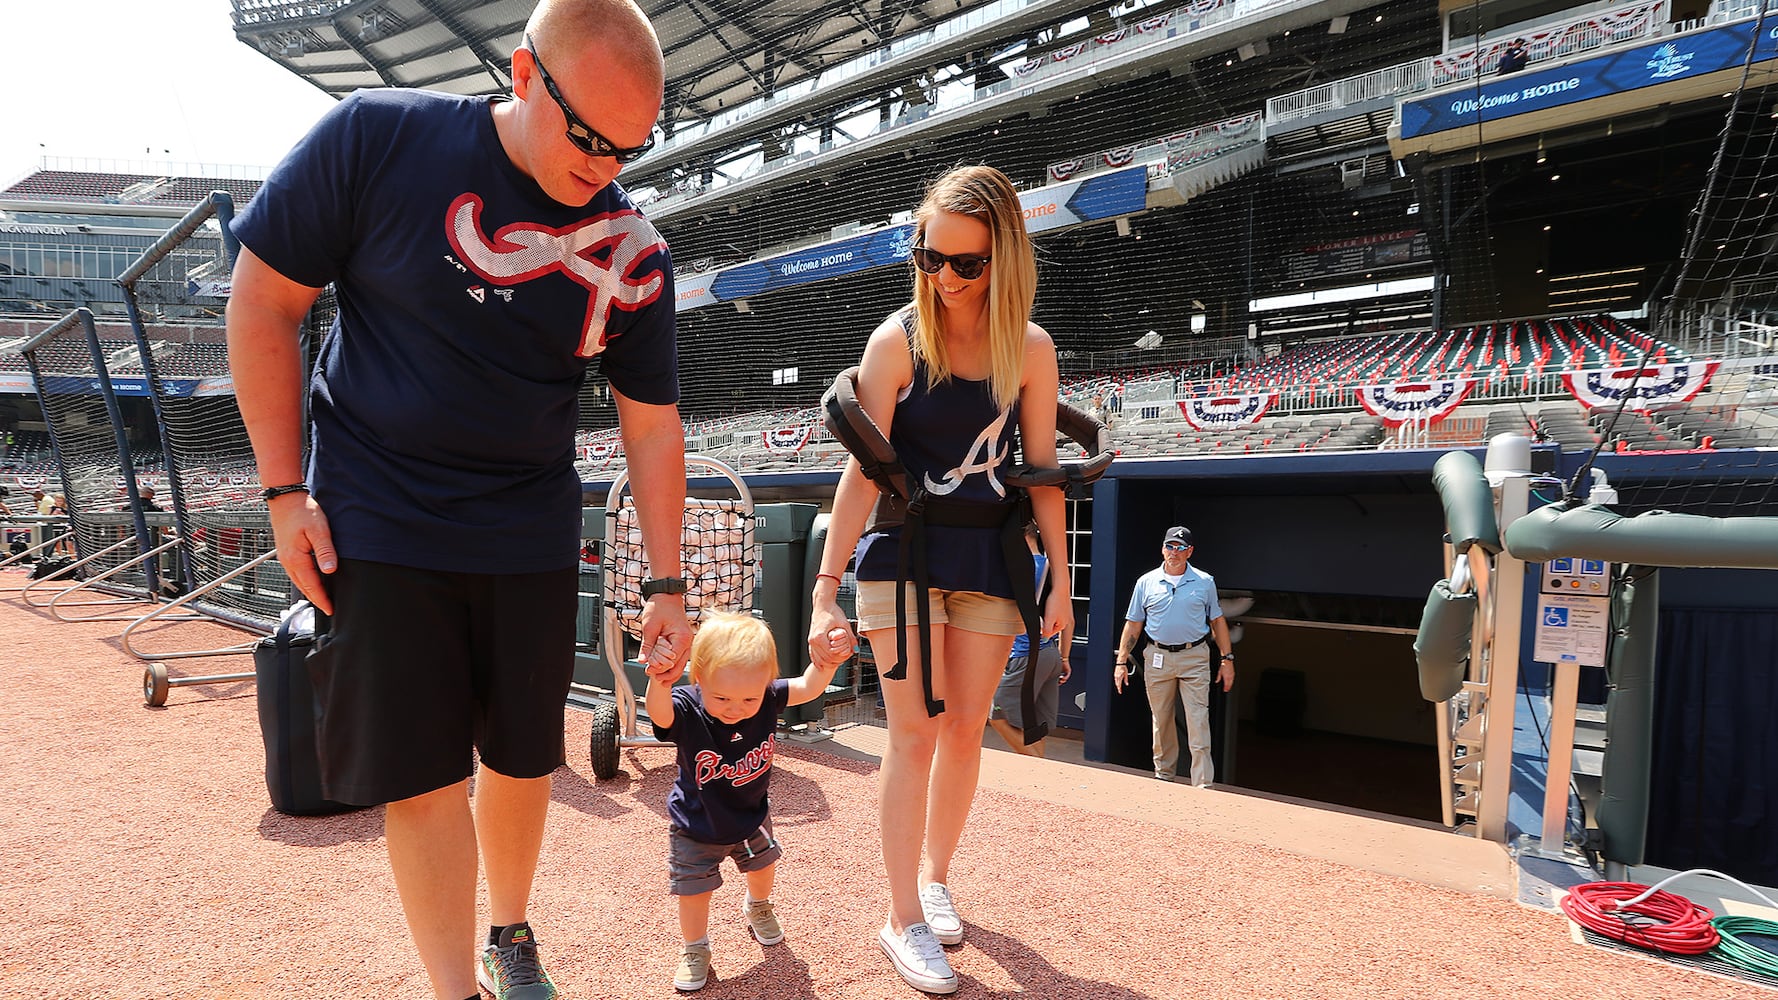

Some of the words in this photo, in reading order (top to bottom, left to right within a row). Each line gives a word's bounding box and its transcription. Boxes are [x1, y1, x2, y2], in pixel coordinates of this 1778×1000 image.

[1451, 92, 1520, 115] Welcome
[1022, 203, 1057, 220] ome
[22, 225, 67, 236] MINOLTA
[1363, 232, 1402, 244] LEVEL
[780, 258, 820, 276] Welcome
[695, 733, 775, 788] Braves
